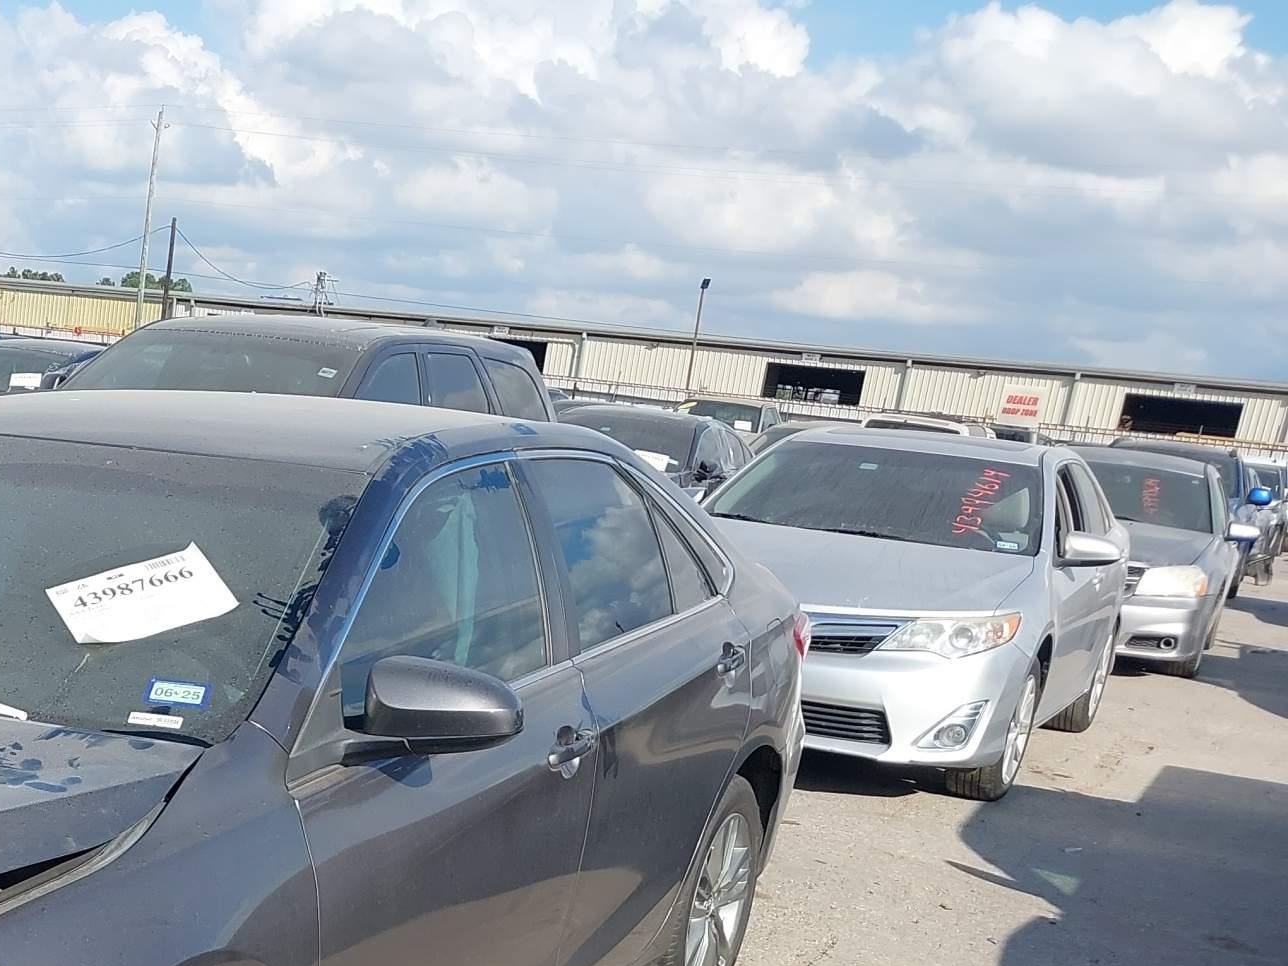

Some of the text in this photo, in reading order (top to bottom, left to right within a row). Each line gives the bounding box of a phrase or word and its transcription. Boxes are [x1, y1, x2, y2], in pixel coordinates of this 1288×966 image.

[1006, 394, 1039, 406] DEALER
[1001, 407, 1038, 417] DROP ZONE
[72, 565, 194, 609] 43987666
